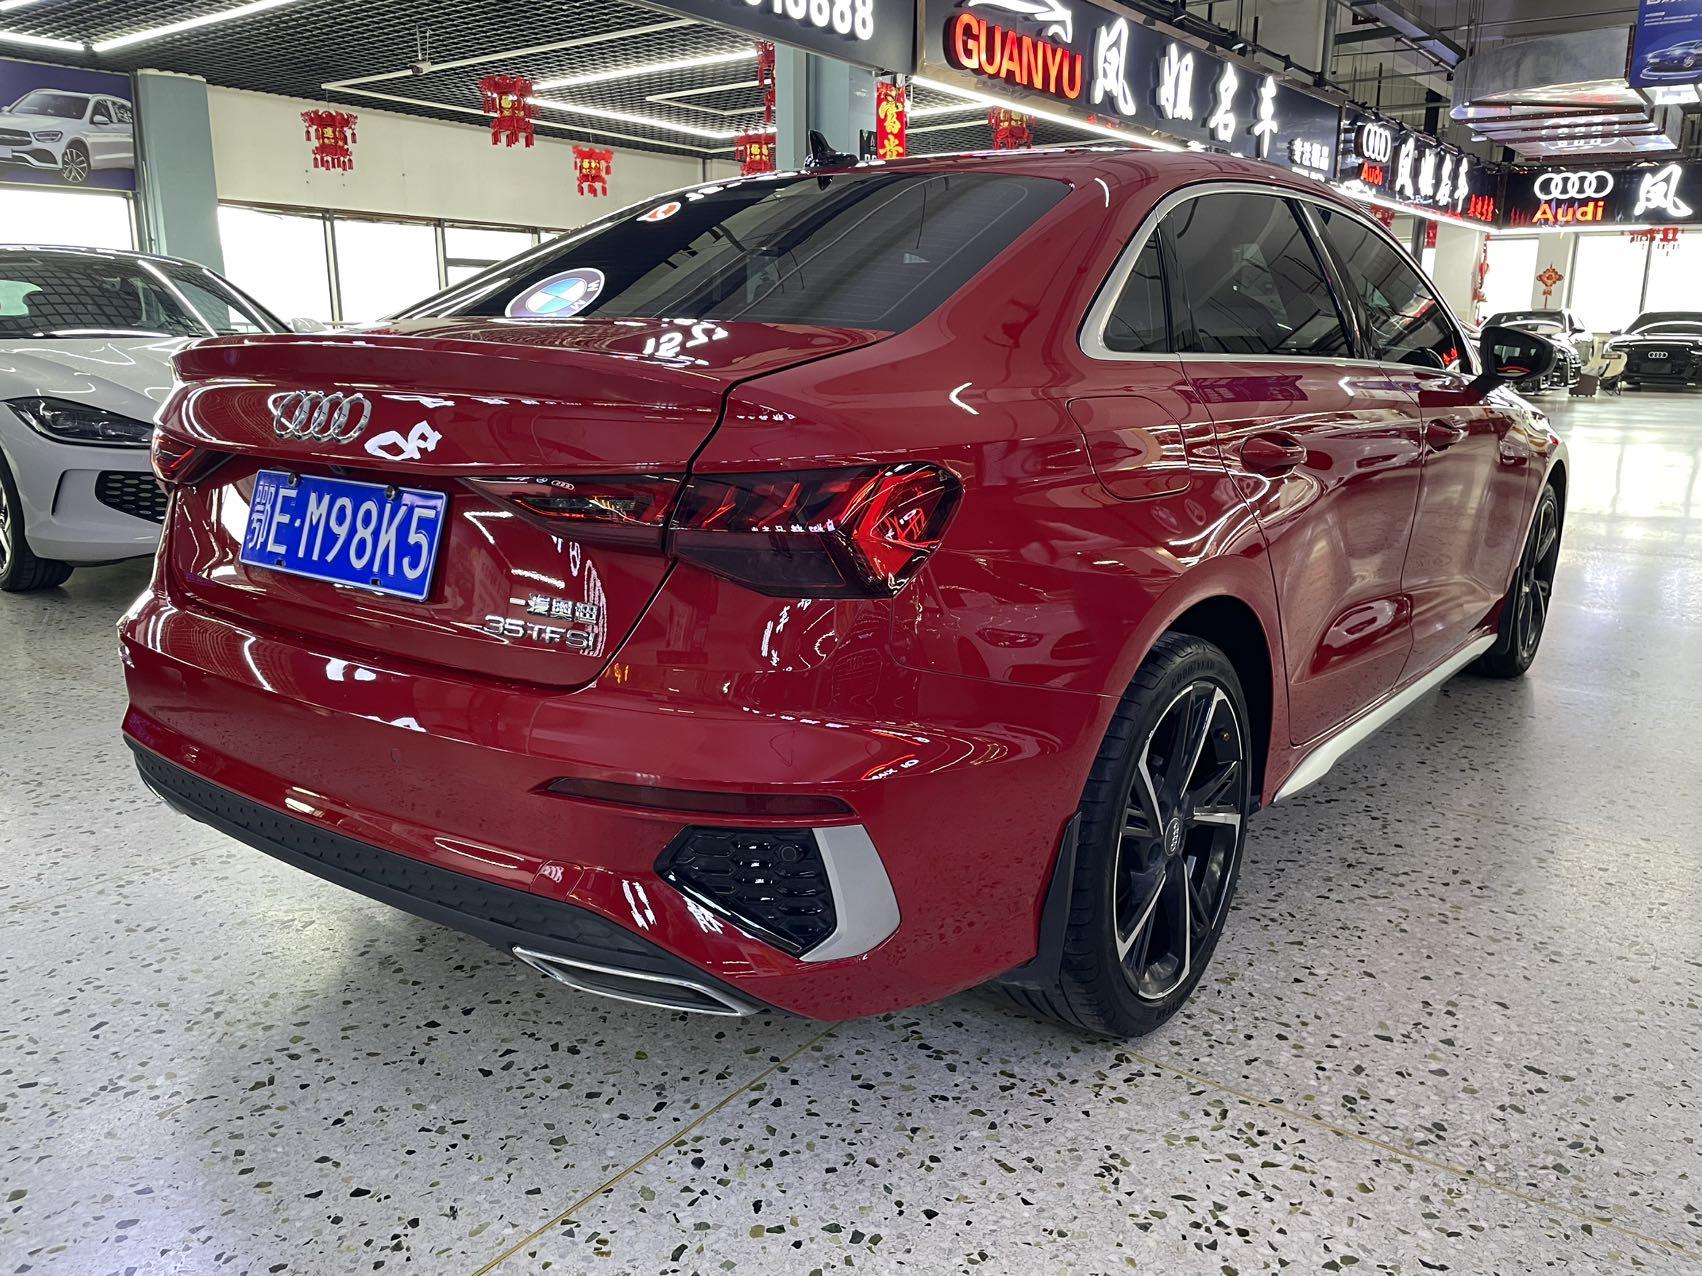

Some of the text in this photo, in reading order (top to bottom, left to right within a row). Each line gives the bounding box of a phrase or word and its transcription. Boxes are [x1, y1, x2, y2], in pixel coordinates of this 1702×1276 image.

[954, 11, 1083, 100] GUANYU
[1360, 161, 1384, 186] Audi
[1531, 200, 1605, 223] Audi
[483, 614, 597, 651] 35 TFSI
